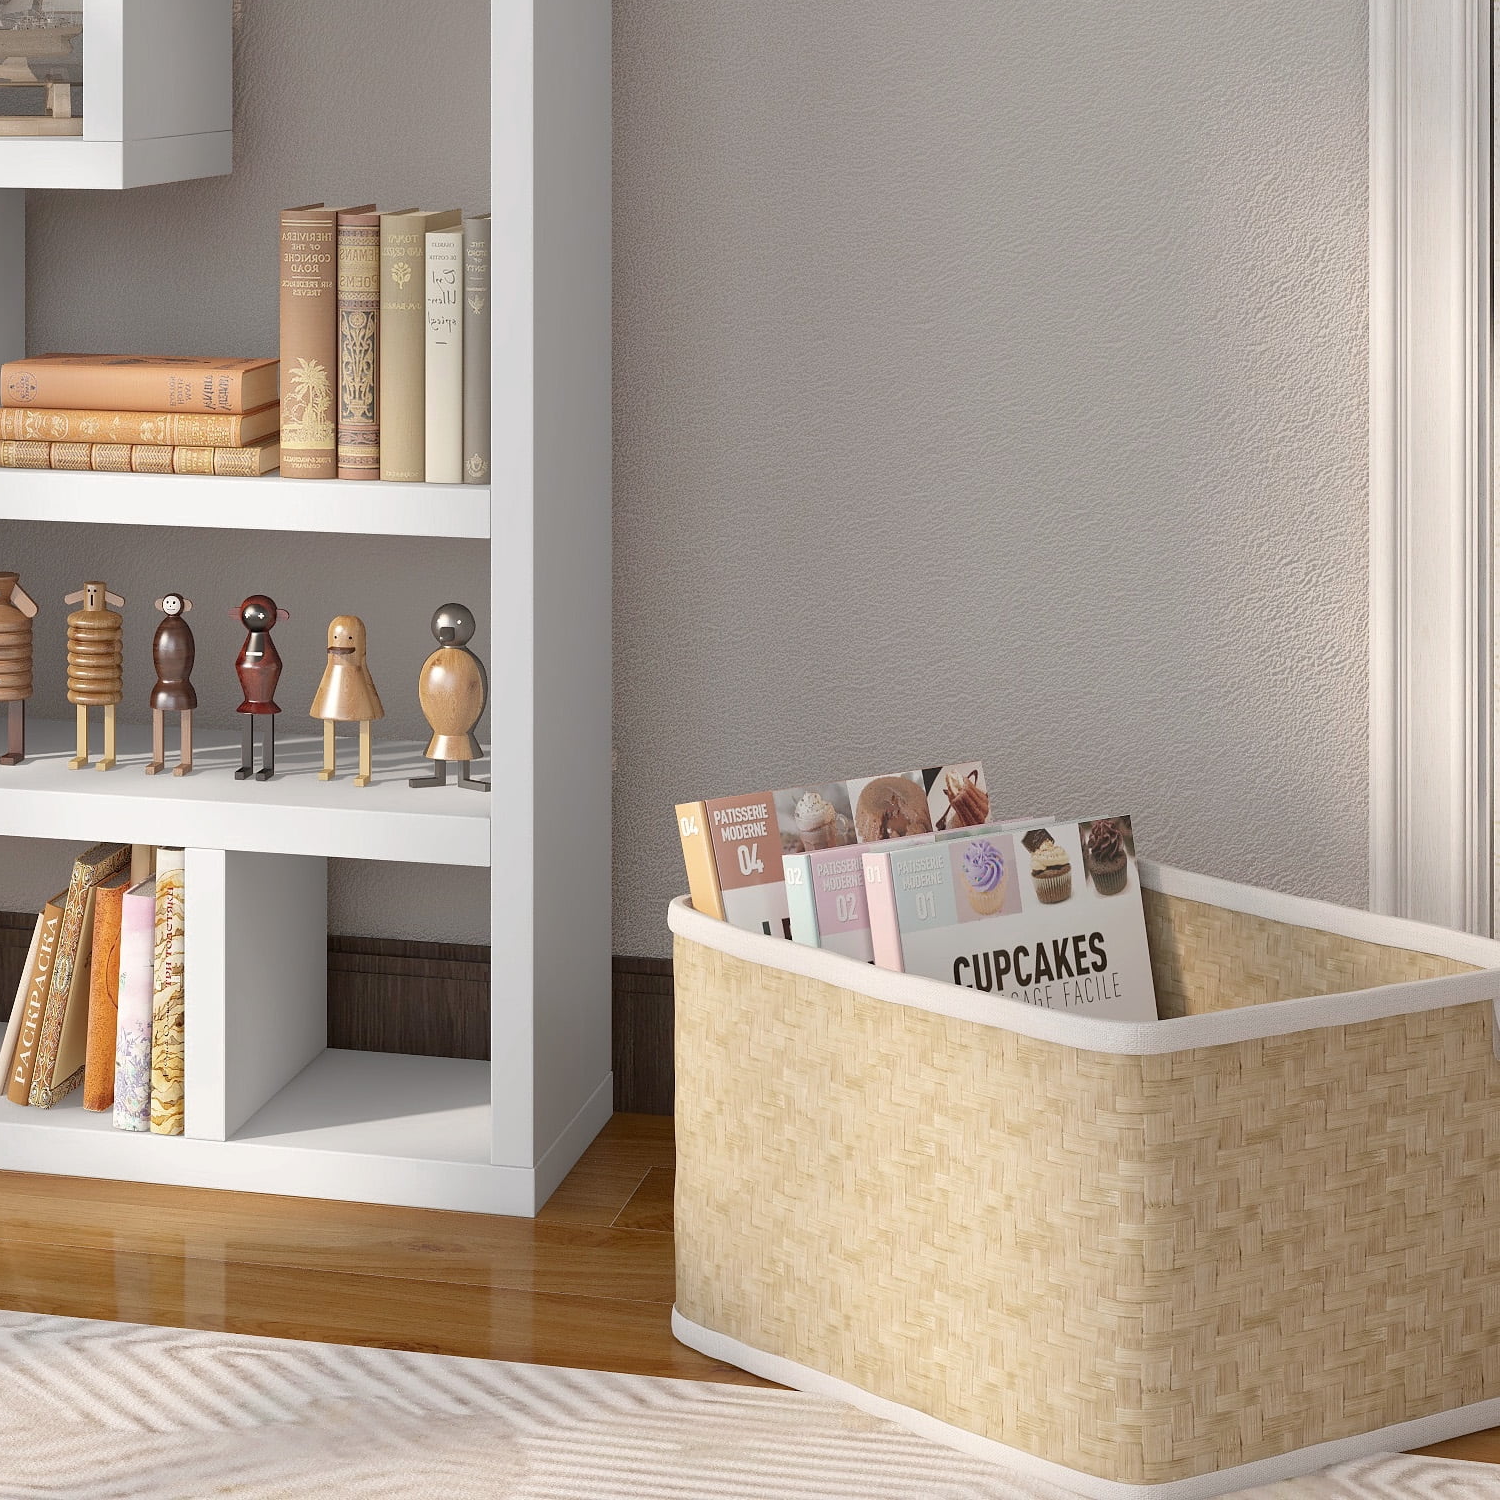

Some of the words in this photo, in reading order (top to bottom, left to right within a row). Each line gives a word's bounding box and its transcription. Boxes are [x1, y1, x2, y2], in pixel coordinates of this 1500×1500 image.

[713, 803, 769, 824] PATISSERIE
[679, 815, 700, 839] 04
[720, 820, 768, 843] MODERNE
[736, 843, 765, 877] 04
[896, 855, 945, 873] PATISSERIE
[784, 867, 803, 888] 02
[866, 864, 883, 884] 01
[900, 871, 944, 891] MODERNE
[835, 893, 860, 922] 02
[914, 891, 938, 921] 01
[953, 931, 1108, 992] CUPCAKES
[14, 916, 59, 1084] РАСКРАСКА
[1063, 971, 1122, 1008] FACILE
